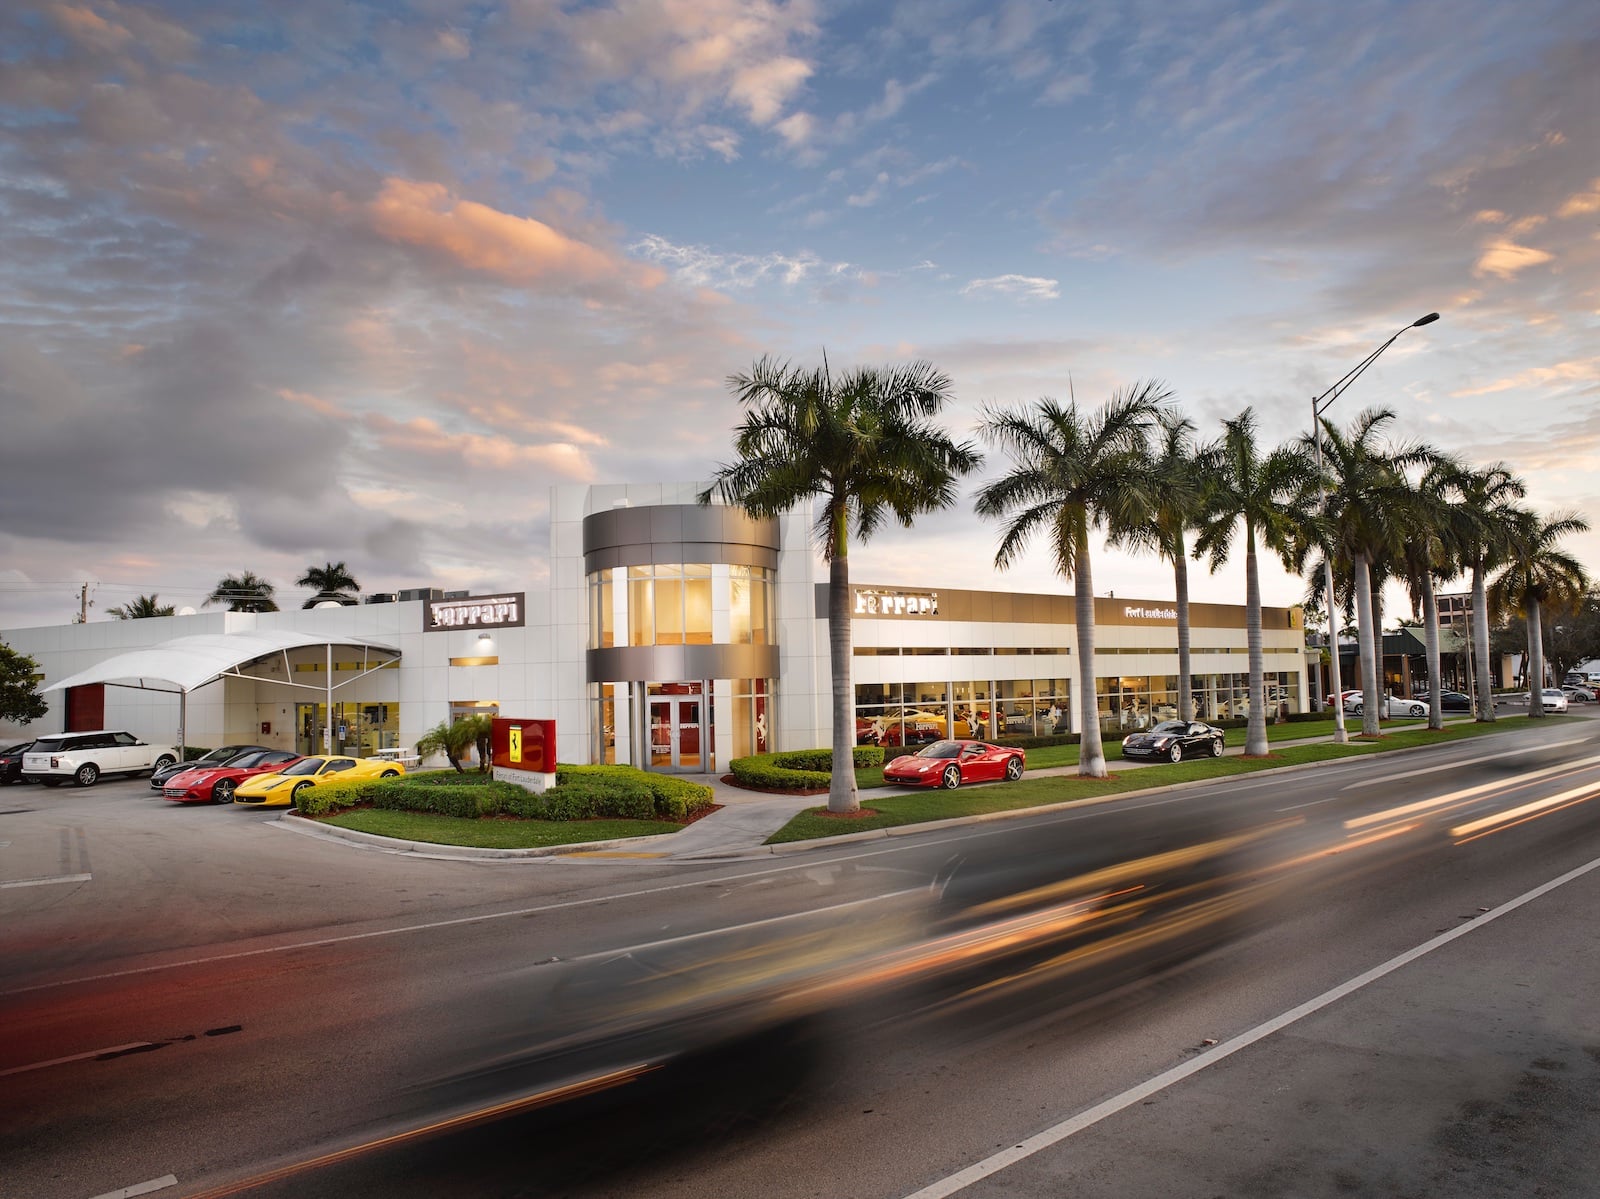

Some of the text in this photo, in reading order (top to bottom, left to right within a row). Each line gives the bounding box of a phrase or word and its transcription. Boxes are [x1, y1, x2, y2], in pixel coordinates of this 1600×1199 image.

[430, 597, 518, 627] Ferrari
[854, 589, 938, 615] Ferrari
[1125, 606, 1141, 618] Fort
